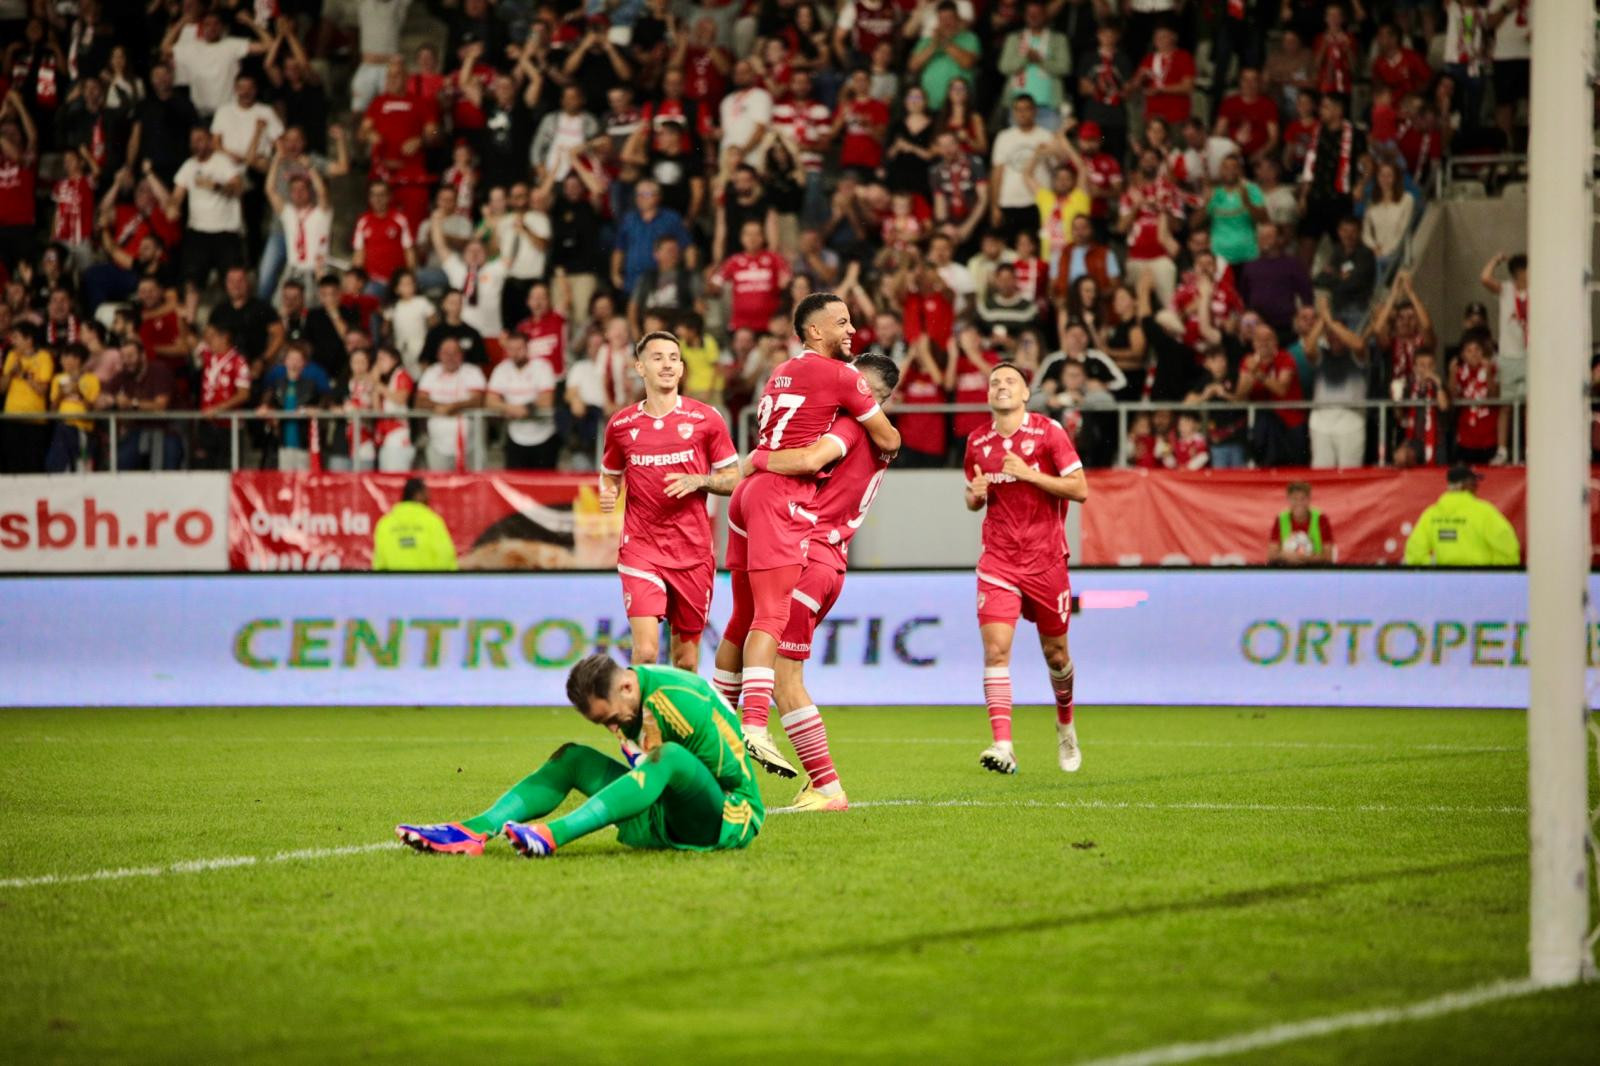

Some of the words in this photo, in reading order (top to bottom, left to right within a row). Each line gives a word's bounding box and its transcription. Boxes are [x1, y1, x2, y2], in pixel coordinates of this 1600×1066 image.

[630, 449, 694, 467] SUPERBET
[0, 498, 215, 551] sbh.ro
[342, 507, 371, 535] la
[1057, 589, 1070, 614] 17
